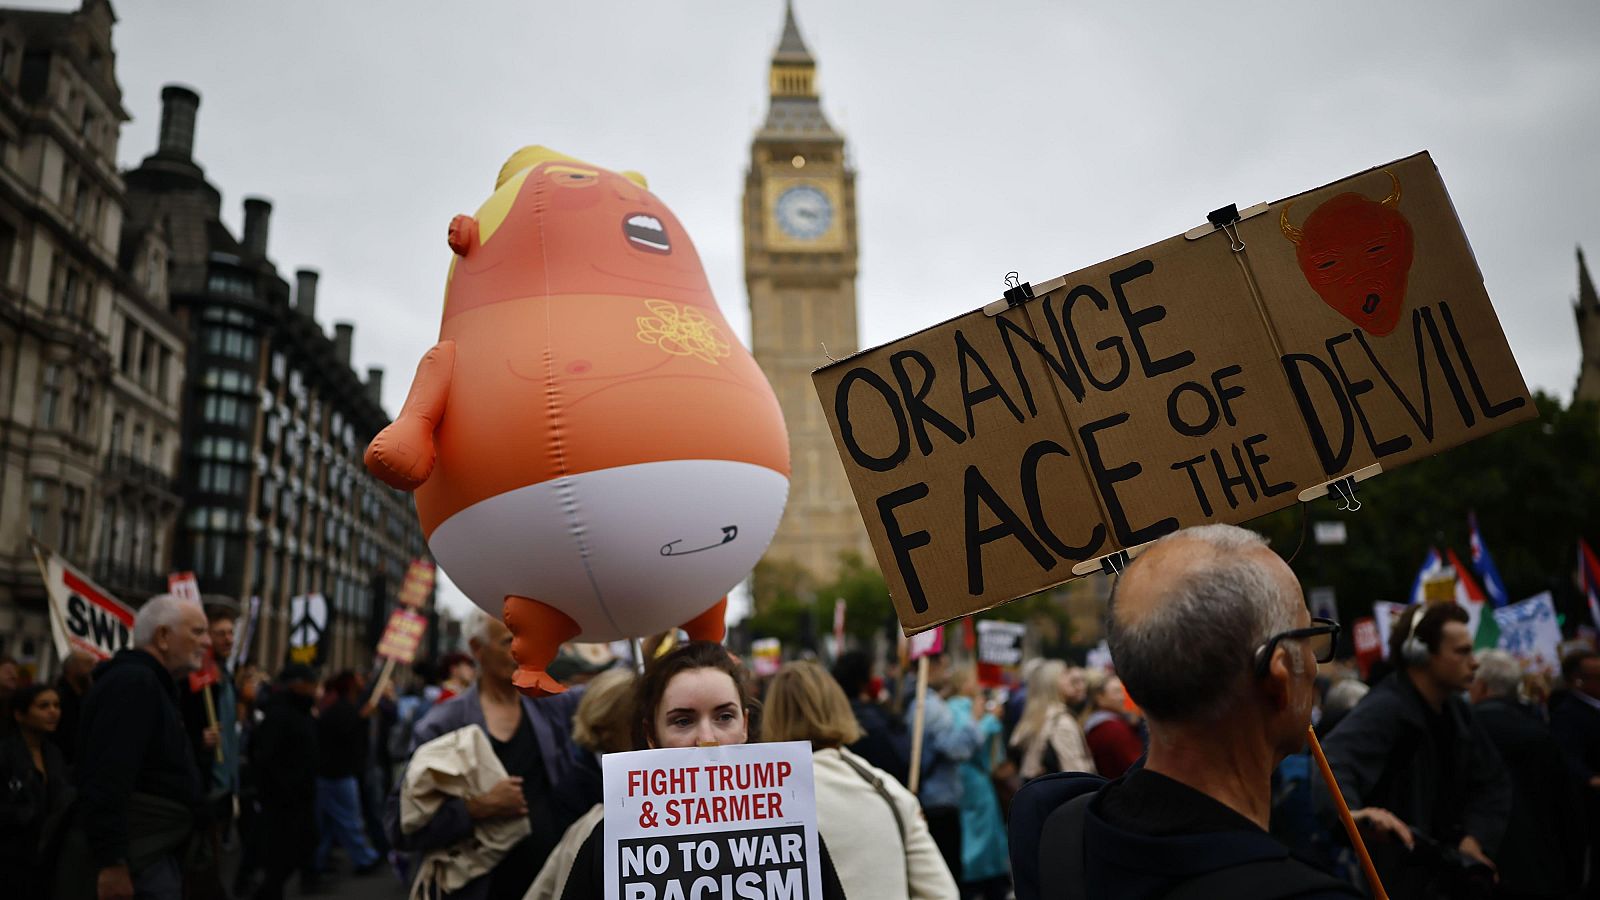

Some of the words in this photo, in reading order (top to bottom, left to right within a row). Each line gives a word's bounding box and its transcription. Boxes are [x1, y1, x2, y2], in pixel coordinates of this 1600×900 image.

[835, 260, 1195, 472] ORANGE
[1167, 365, 1245, 436] OF
[1281, 302, 1525, 475] DEVIL
[876, 412, 1179, 614] FACE
[1171, 433, 1296, 517] THE
[628, 767, 700, 797] FIGHT
[705, 761, 792, 792] TRUMP
[639, 801, 658, 829] &
[665, 792, 783, 826] STARMER
[622, 844, 670, 877] NO
[678, 840, 720, 872] TO
[727, 833, 804, 868] WAR
